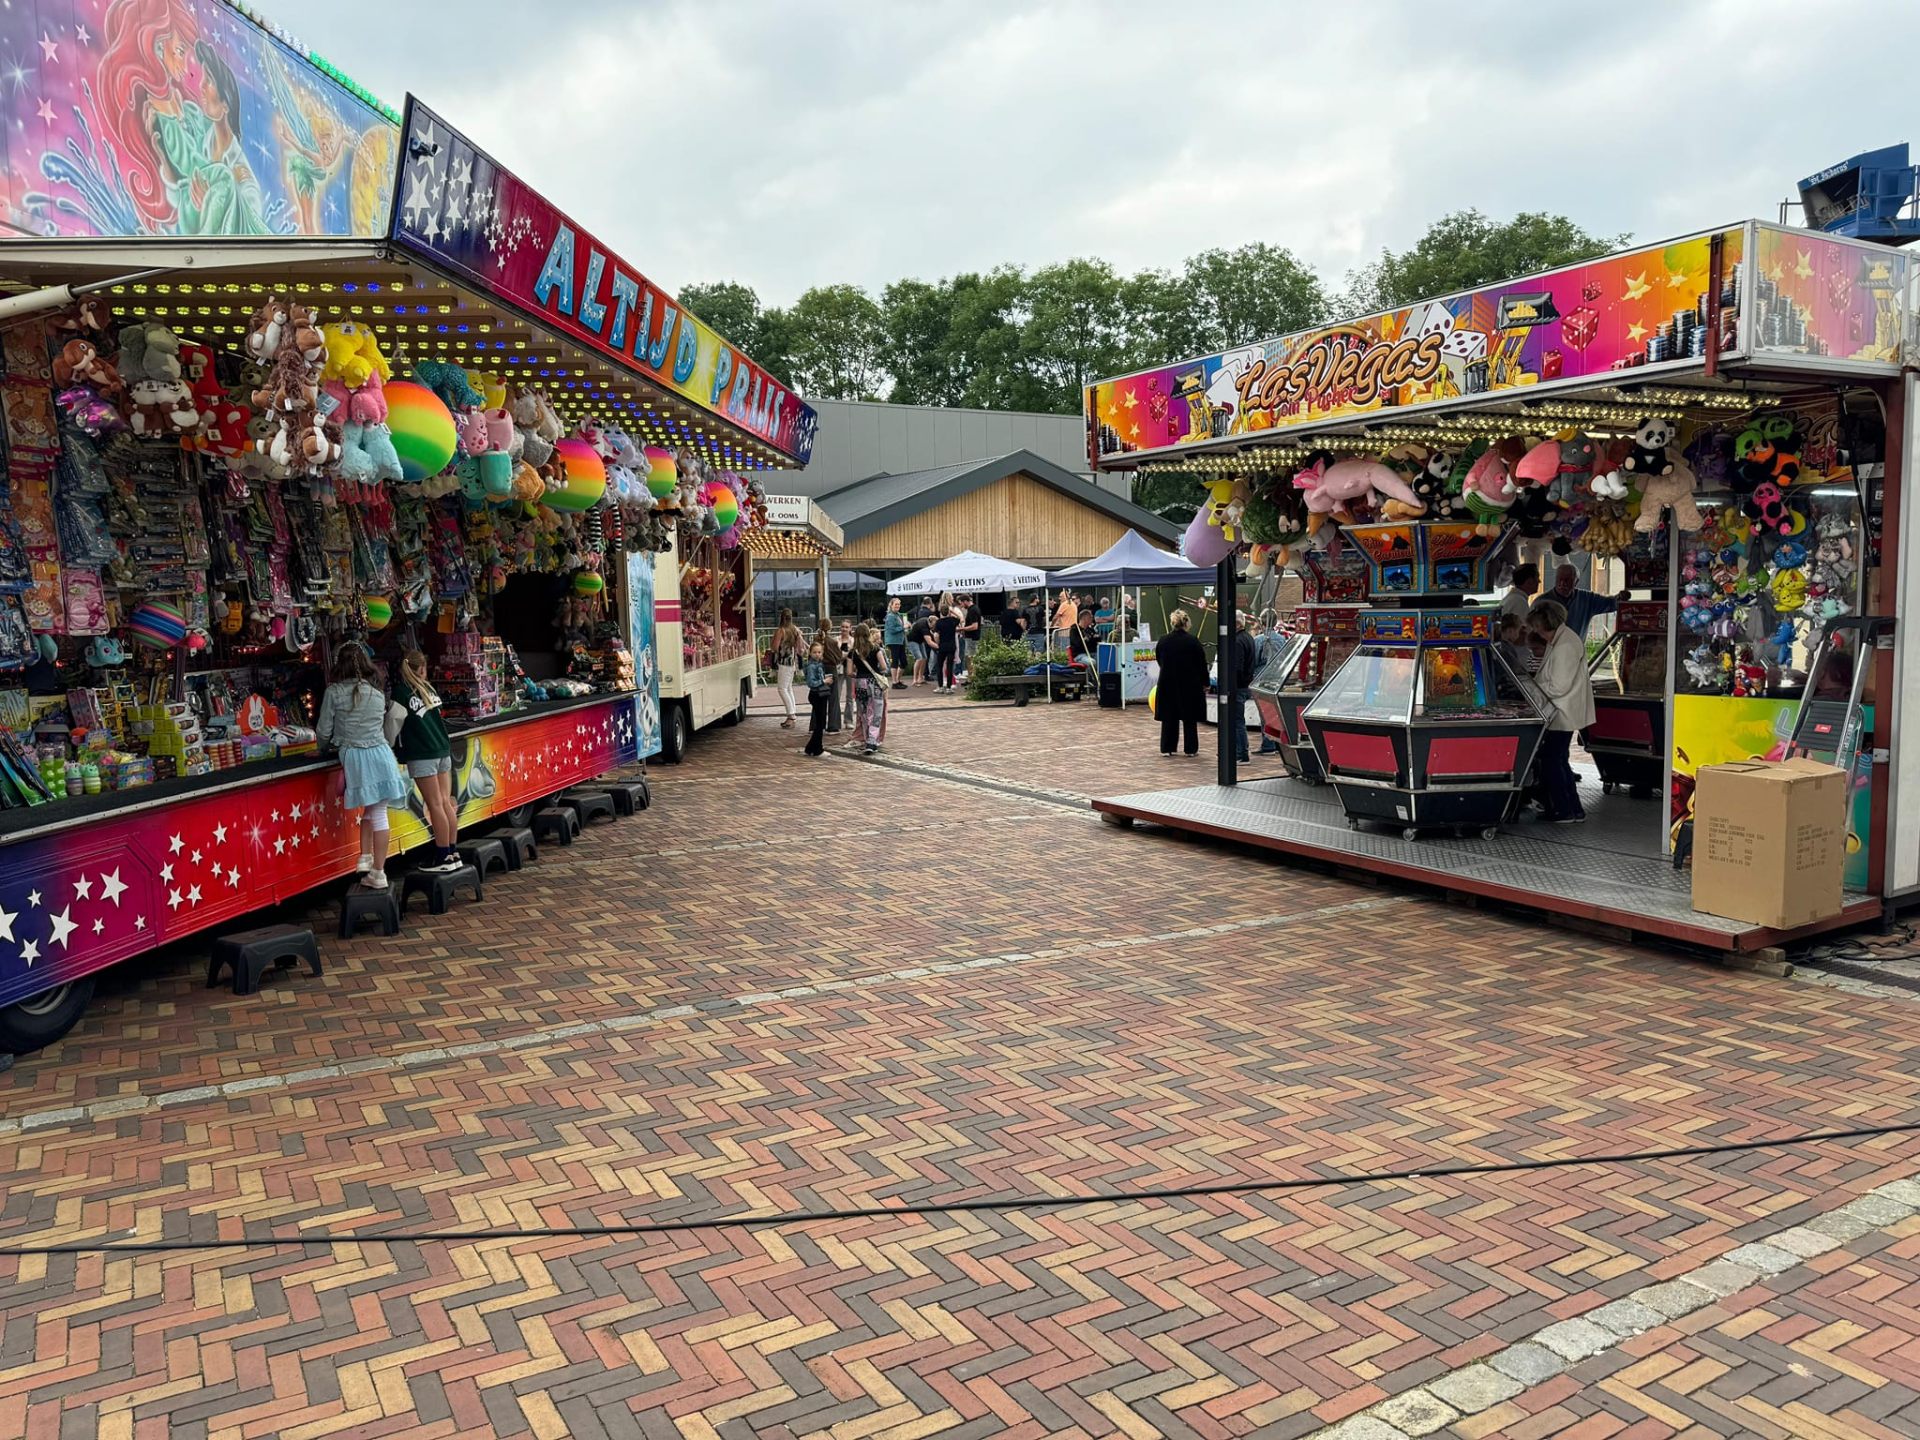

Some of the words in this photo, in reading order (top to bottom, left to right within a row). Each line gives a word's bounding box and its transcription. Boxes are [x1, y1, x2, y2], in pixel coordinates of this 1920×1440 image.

[534, 221, 698, 384] ALTIJD
[710, 343, 785, 439] PRIJS
[954, 577, 986, 587] VELTINS
[1017, 575, 1041, 585] VELTINS
[902, 582, 923, 591] VELTINS
